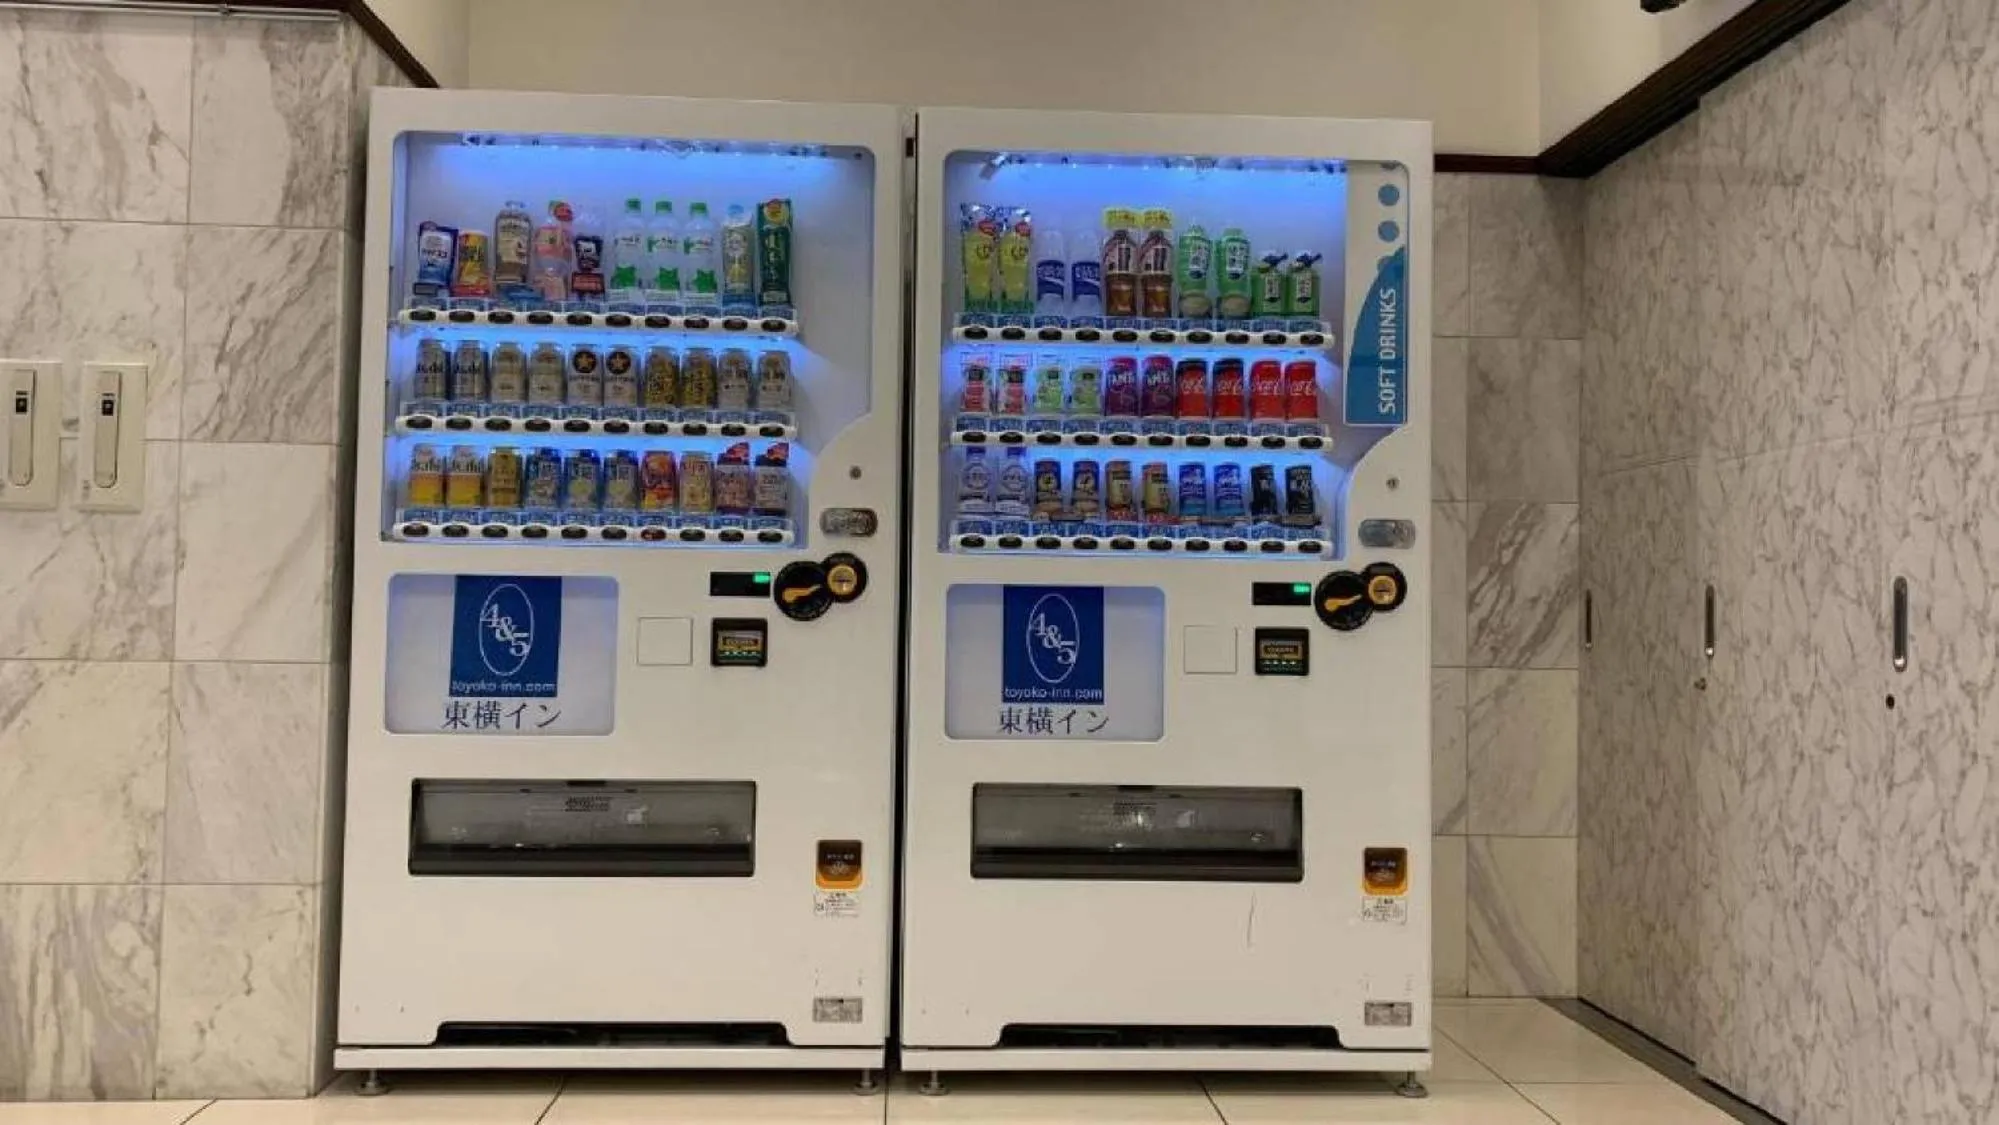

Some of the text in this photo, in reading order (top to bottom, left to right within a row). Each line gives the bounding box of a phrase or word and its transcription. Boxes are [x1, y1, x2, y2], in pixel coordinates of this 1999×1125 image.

[1380, 287, 1397, 417] SOFT DRINKS
[480, 603, 530, 657] 4&5
[1030, 612, 1077, 665] 4&5
[452, 681, 556, 694] toyoko-inn.com
[1004, 687, 1103, 700] toyoko-inn.com
[442, 700, 562, 730] 東横イン
[998, 707, 1109, 736] 東横イン
